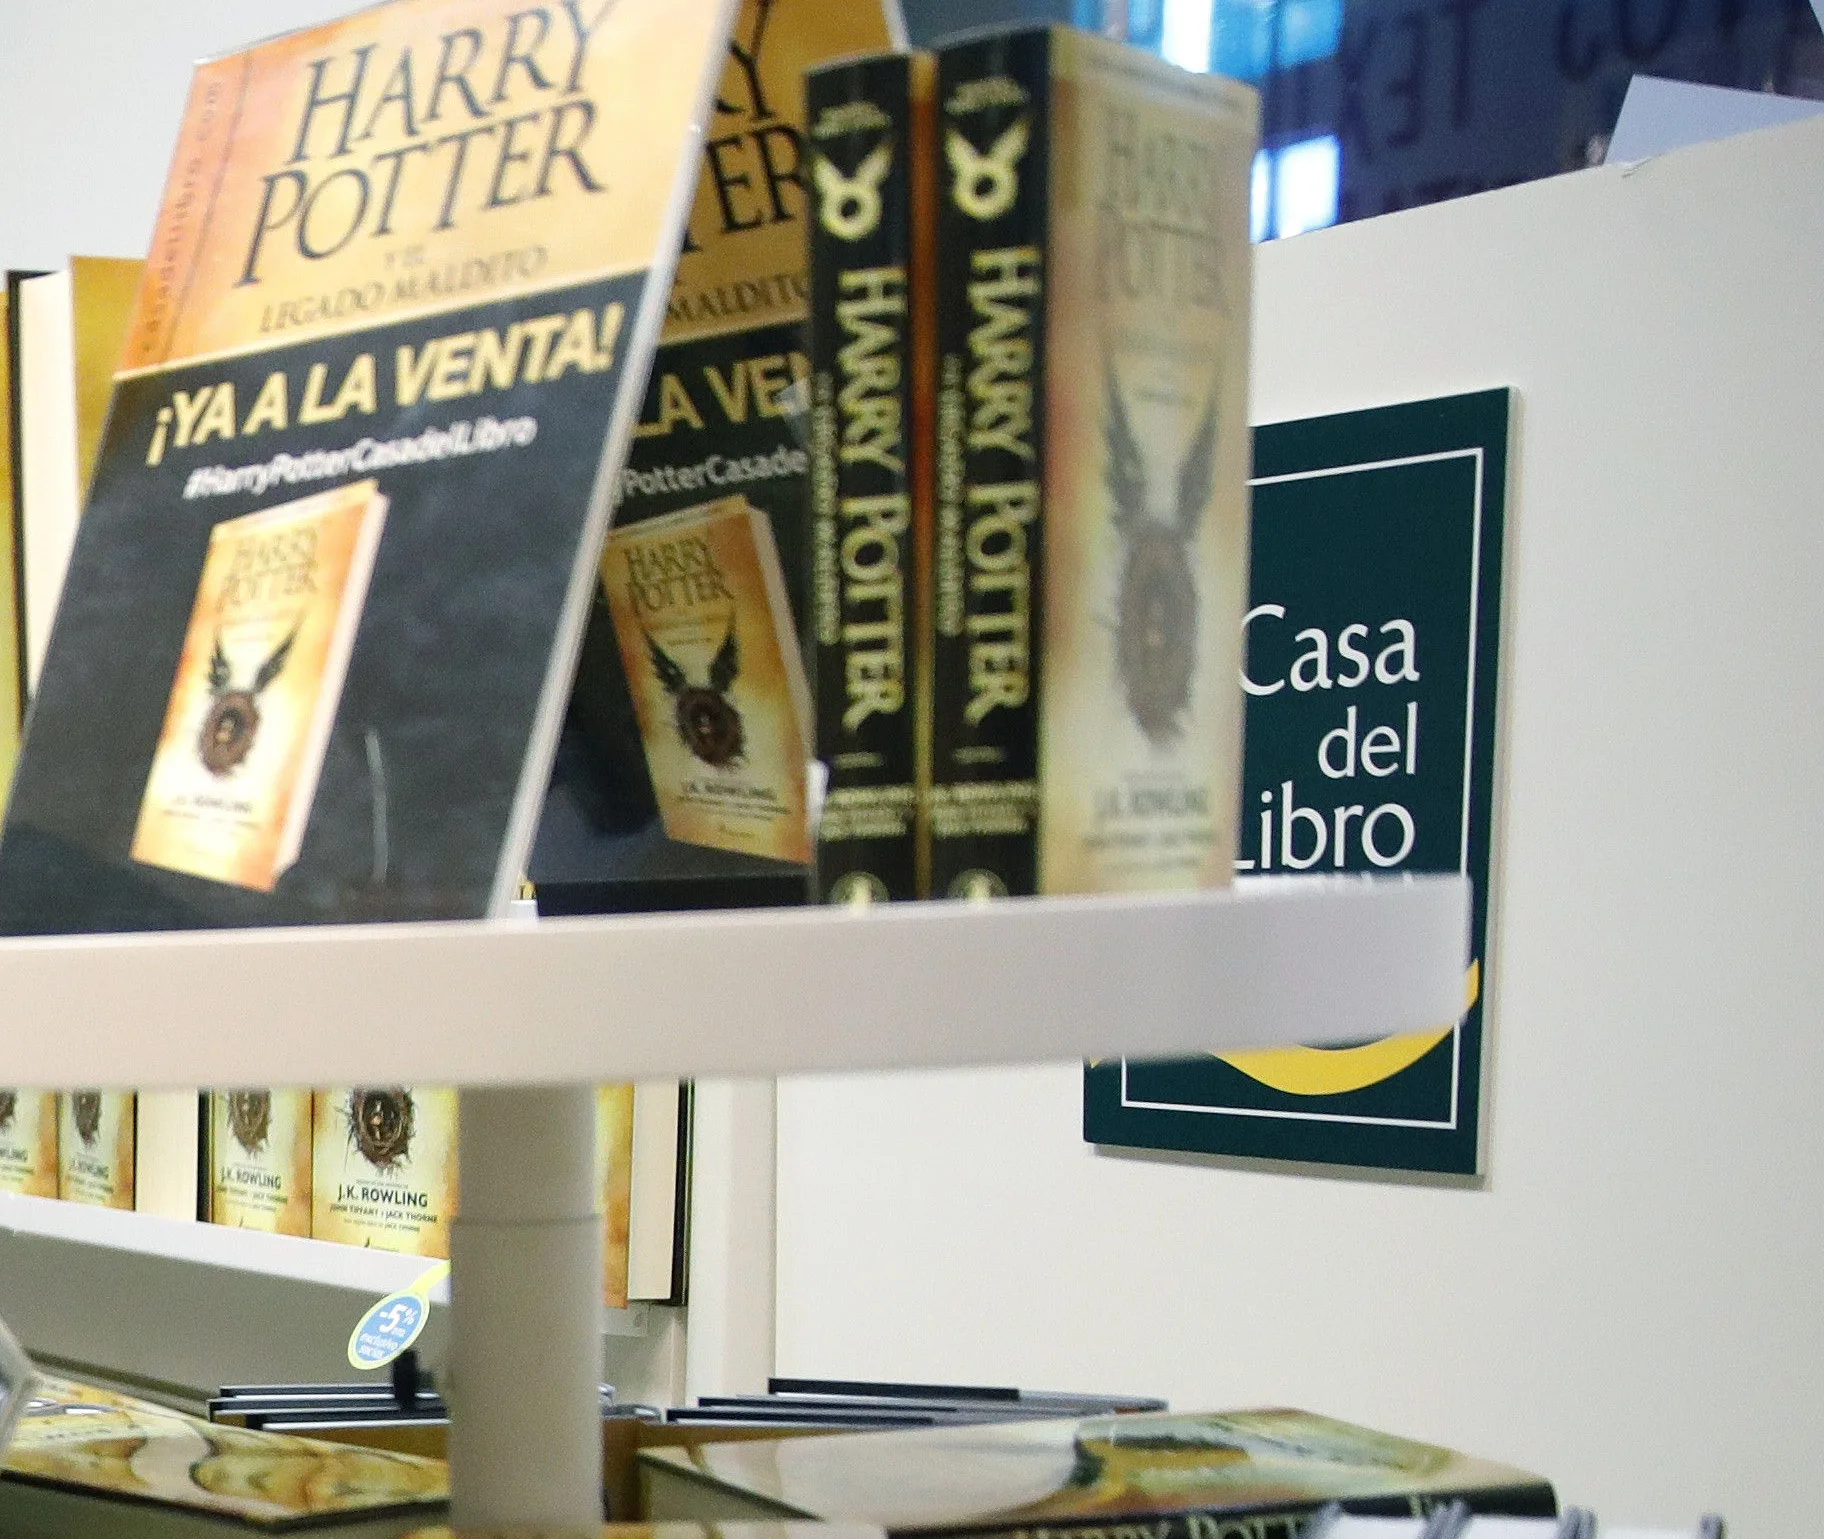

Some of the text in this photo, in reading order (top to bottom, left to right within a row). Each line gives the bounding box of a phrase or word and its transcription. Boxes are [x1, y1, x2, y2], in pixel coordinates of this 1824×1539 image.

[284, 0, 624, 166] HARRY
[233, 97, 609, 288] POTTER
[259, 245, 549, 334] LEGADO MALDITO
[836, 266, 909, 474] HARRY
[966, 246, 1042, 460] HARRY
[146, 302, 625, 467] ¡YA A LA VENTA!
[840, 493, 911, 732] POTTER
[964, 480, 1040, 729] POTTER
[1239, 603, 1420, 697] Casa
[1317, 703, 1418, 780] del
[338, 1184, 429, 1208] J.K. ROWLING
